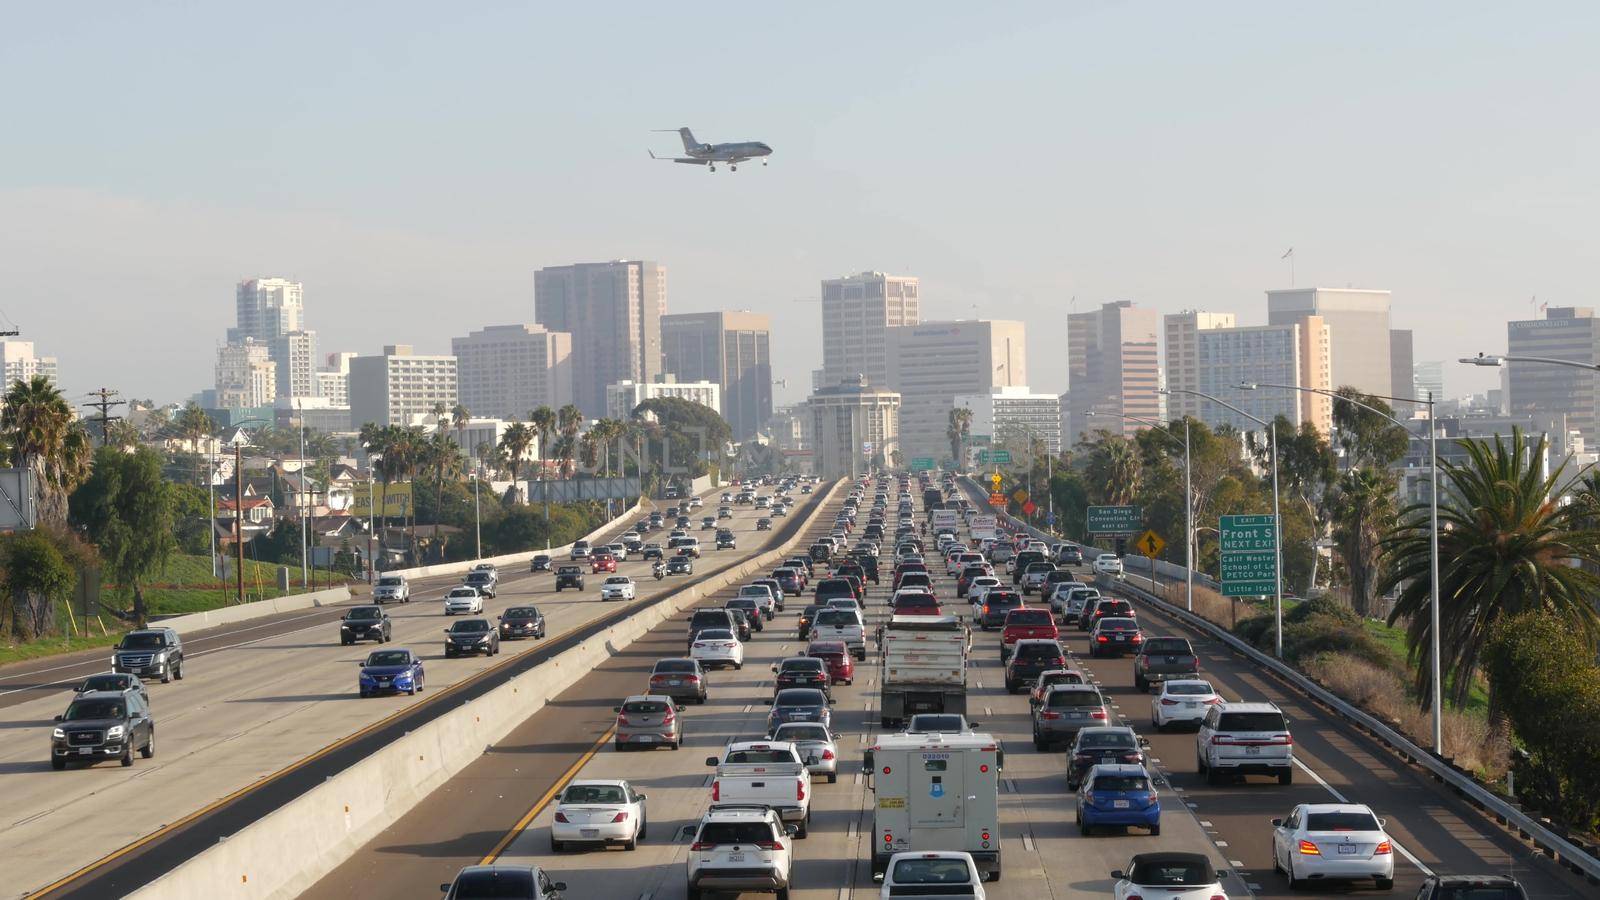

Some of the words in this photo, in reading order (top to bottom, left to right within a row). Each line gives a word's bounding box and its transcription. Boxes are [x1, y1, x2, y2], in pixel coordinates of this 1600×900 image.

[1222, 529, 1258, 539] Front
[1224, 540, 1250, 548] NEXT
[1228, 585, 1252, 593] Little
[1255, 585, 1276, 593] Italy
